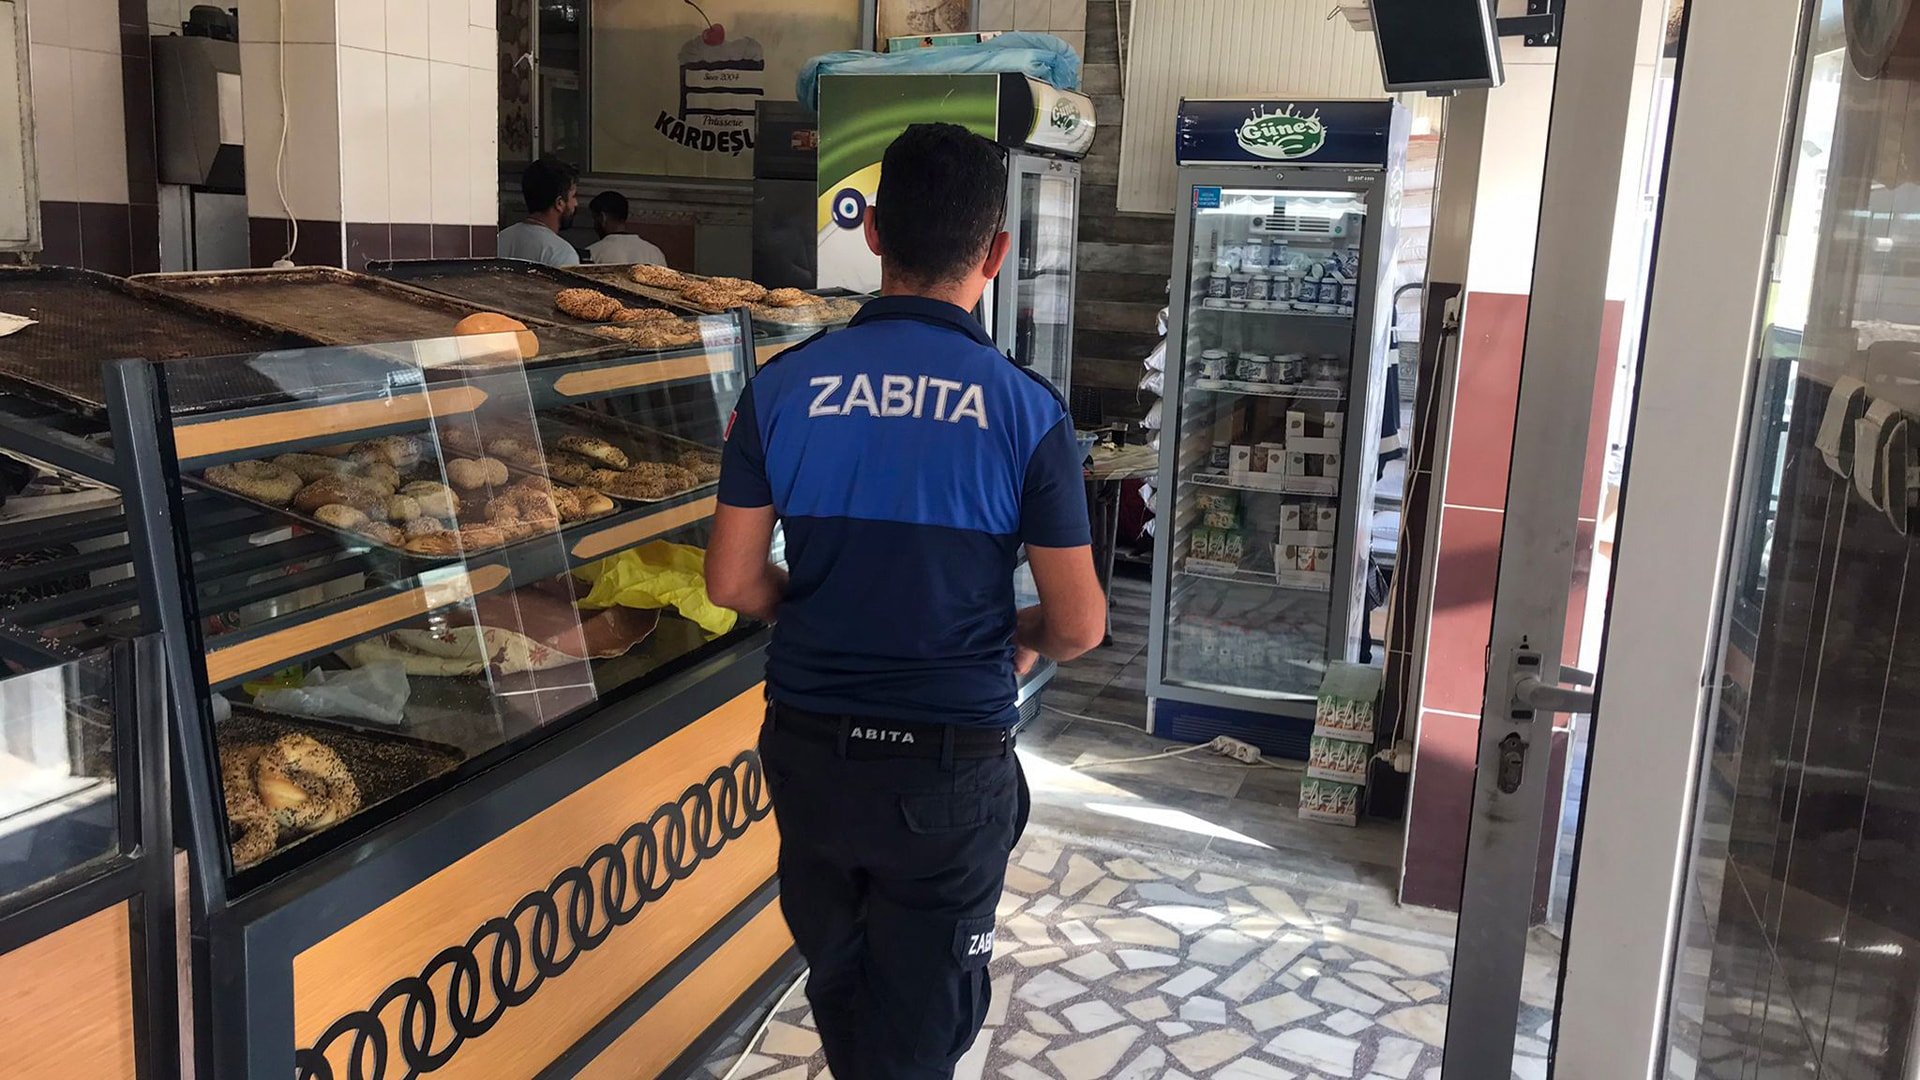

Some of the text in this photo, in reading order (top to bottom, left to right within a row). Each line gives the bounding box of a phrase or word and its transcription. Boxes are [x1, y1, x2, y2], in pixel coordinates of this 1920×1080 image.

[654, 110, 754, 156] KARDEŞL
[1243, 121, 1320, 140] Güney
[808, 373, 989, 430] ZABITA
[851, 727, 915, 744] ABITA
